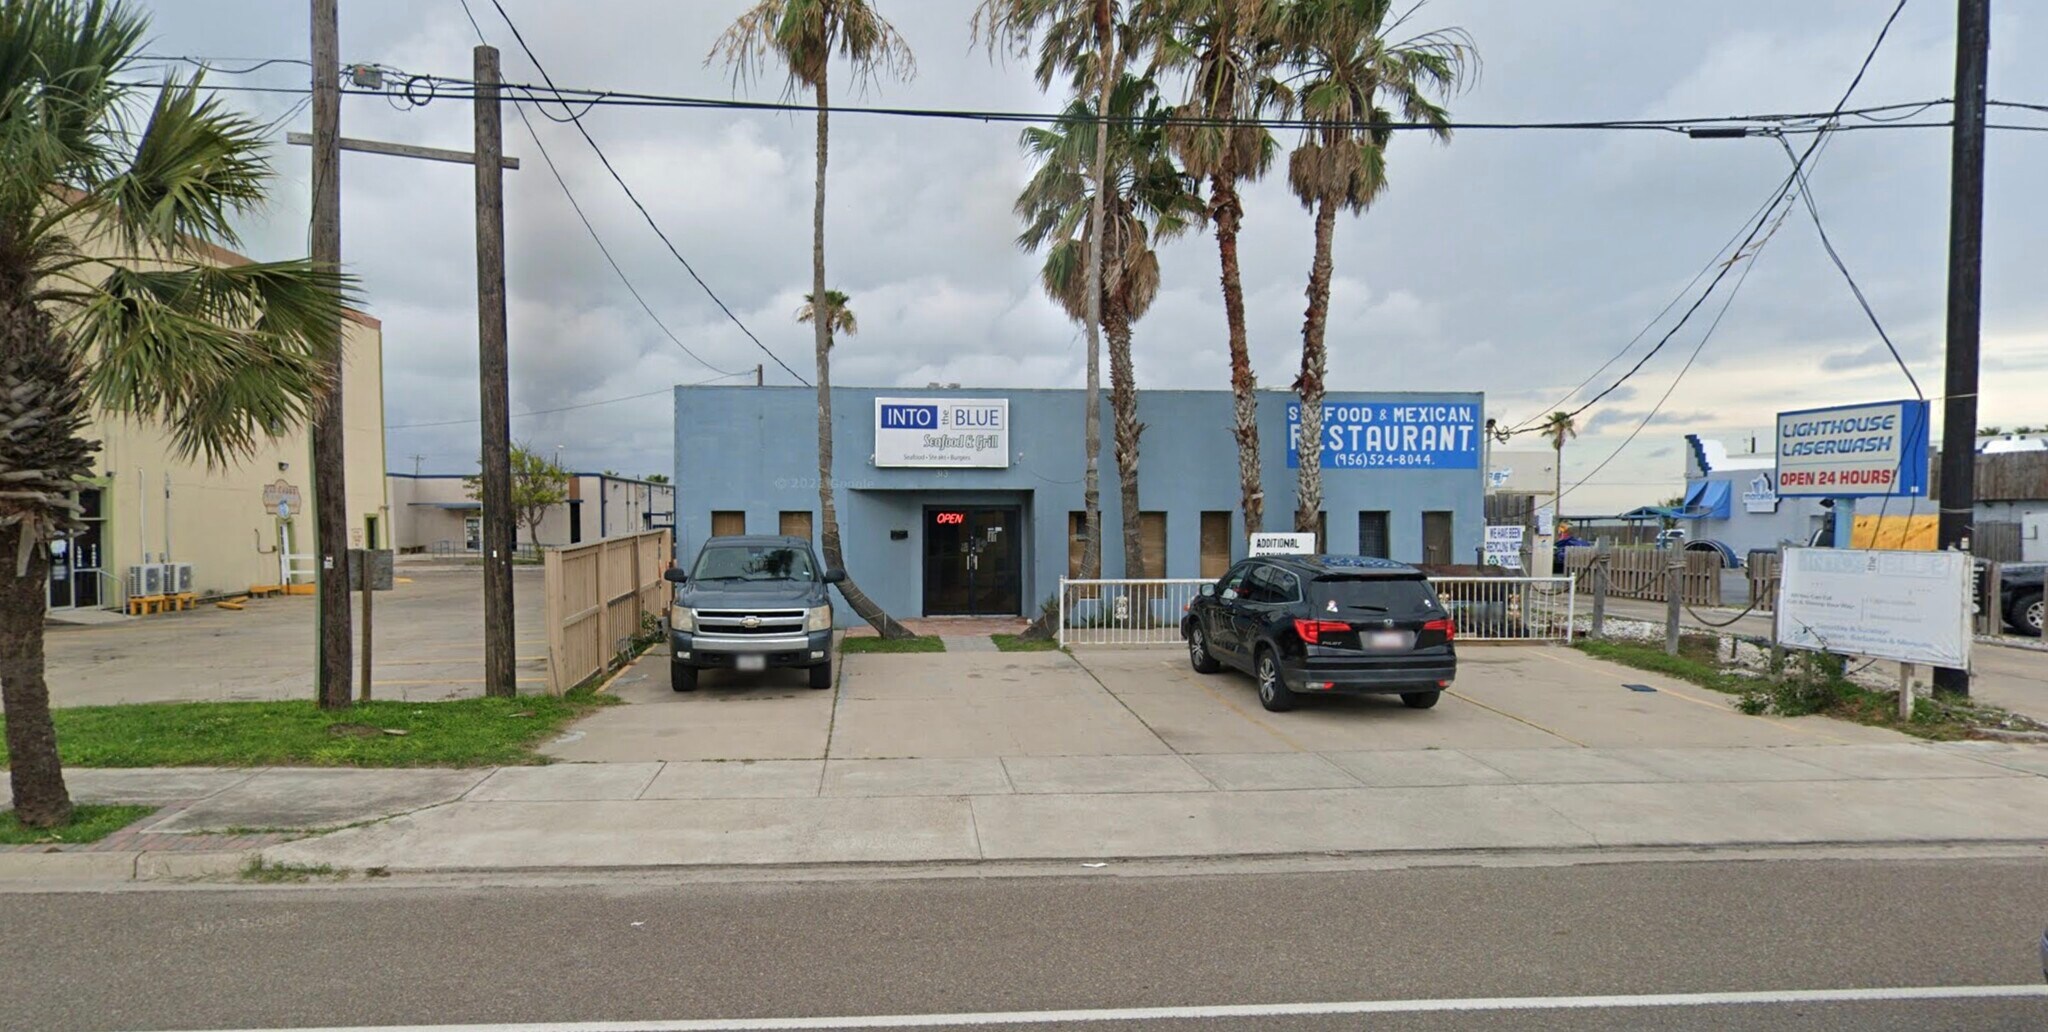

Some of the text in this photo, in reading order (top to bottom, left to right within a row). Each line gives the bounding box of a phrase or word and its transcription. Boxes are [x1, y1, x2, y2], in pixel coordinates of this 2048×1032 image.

[888, 408, 999, 426] INTO the BLUE
[1288, 406, 1475, 423] SFOOD & MEXICAN.
[1782, 415, 1896, 438] LIGHTHOUSE
[923, 434, 999, 451] Seafood & Grill
[1290, 424, 1475, 452] RSTAURANT.
[1782, 436, 1893, 457] LASERWASH
[1780, 469, 1896, 486] OPEN 24 HOURS!
[936, 513, 964, 524] OPEN
[1256, 538, 1300, 549] ADDITIONAL
